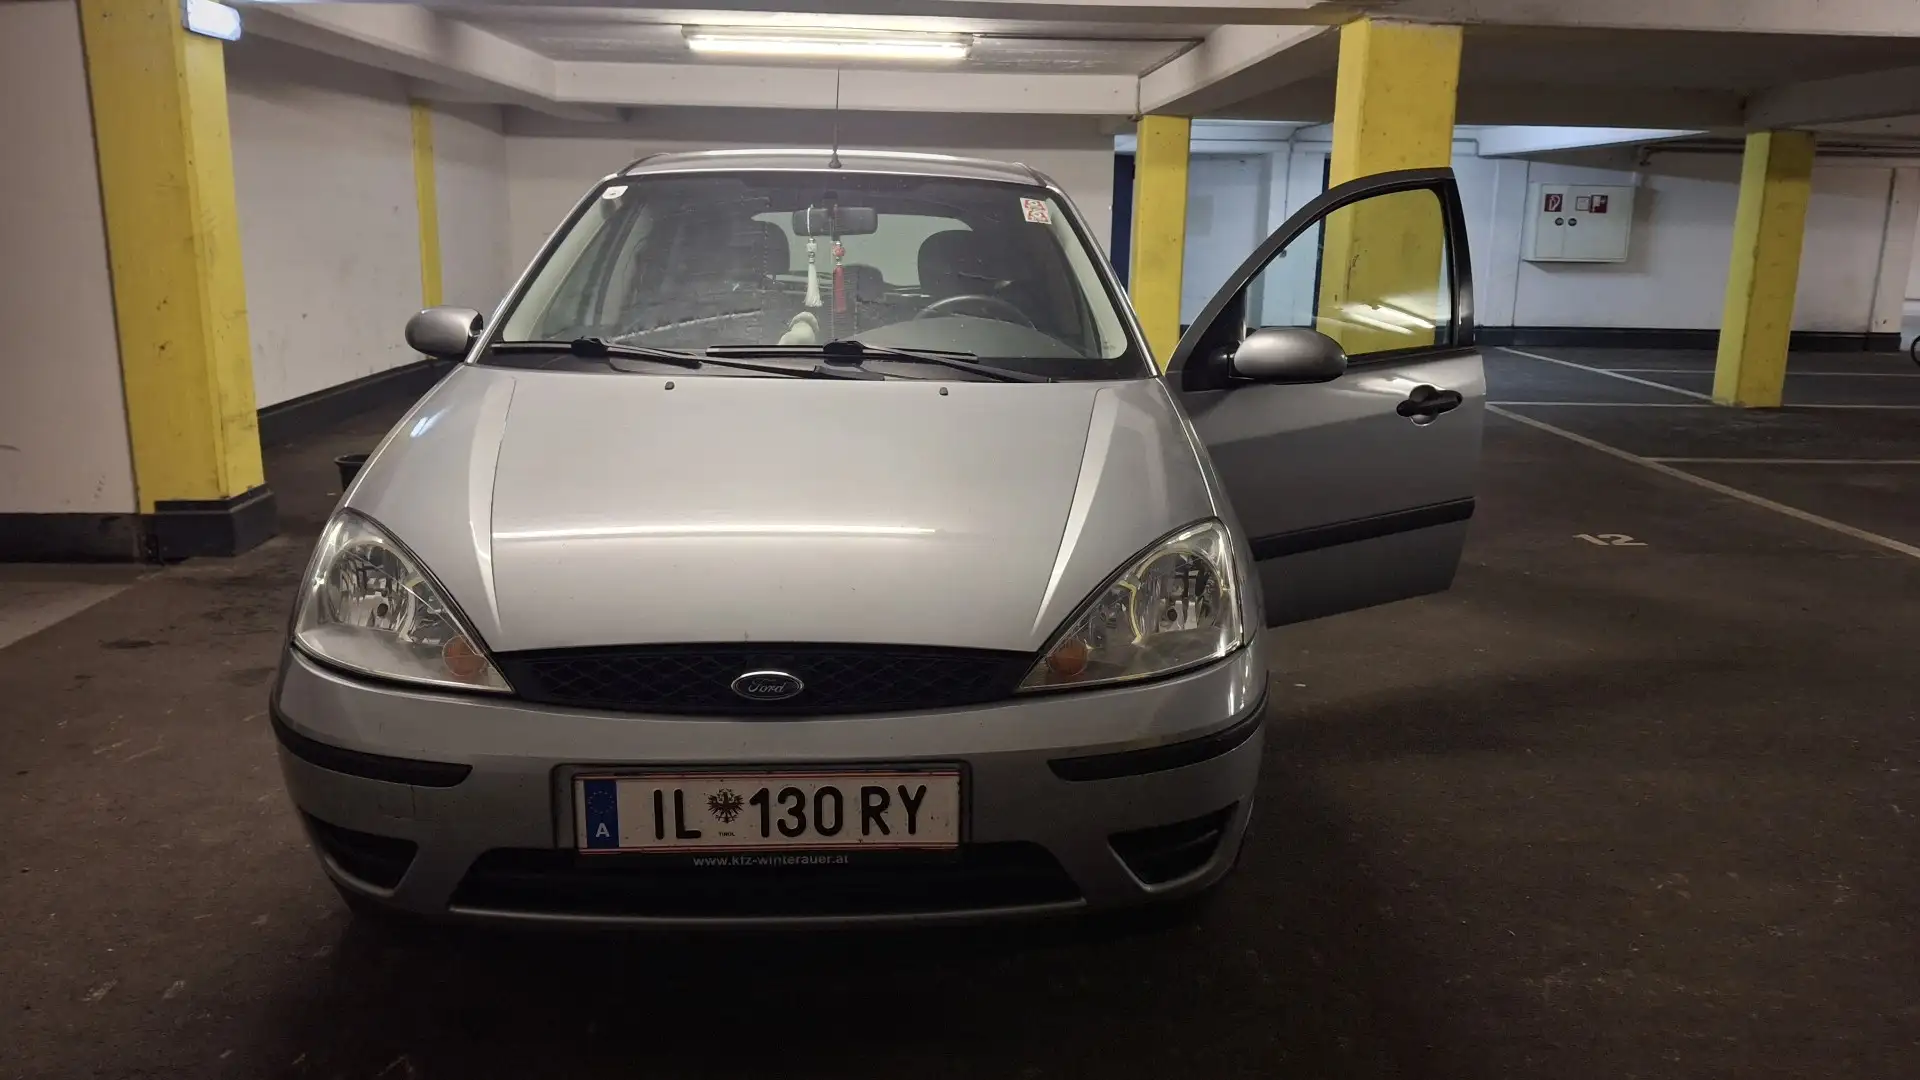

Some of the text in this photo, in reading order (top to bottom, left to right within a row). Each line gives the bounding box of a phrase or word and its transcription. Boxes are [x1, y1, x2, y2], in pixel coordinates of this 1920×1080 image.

[1572, 533, 1649, 546] 12
[748, 678, 787, 693] Ford
[653, 784, 927, 840] IL 130 RY
[595, 822, 610, 838] A
[693, 854, 849, 867] www.kfz-winterauer.at
